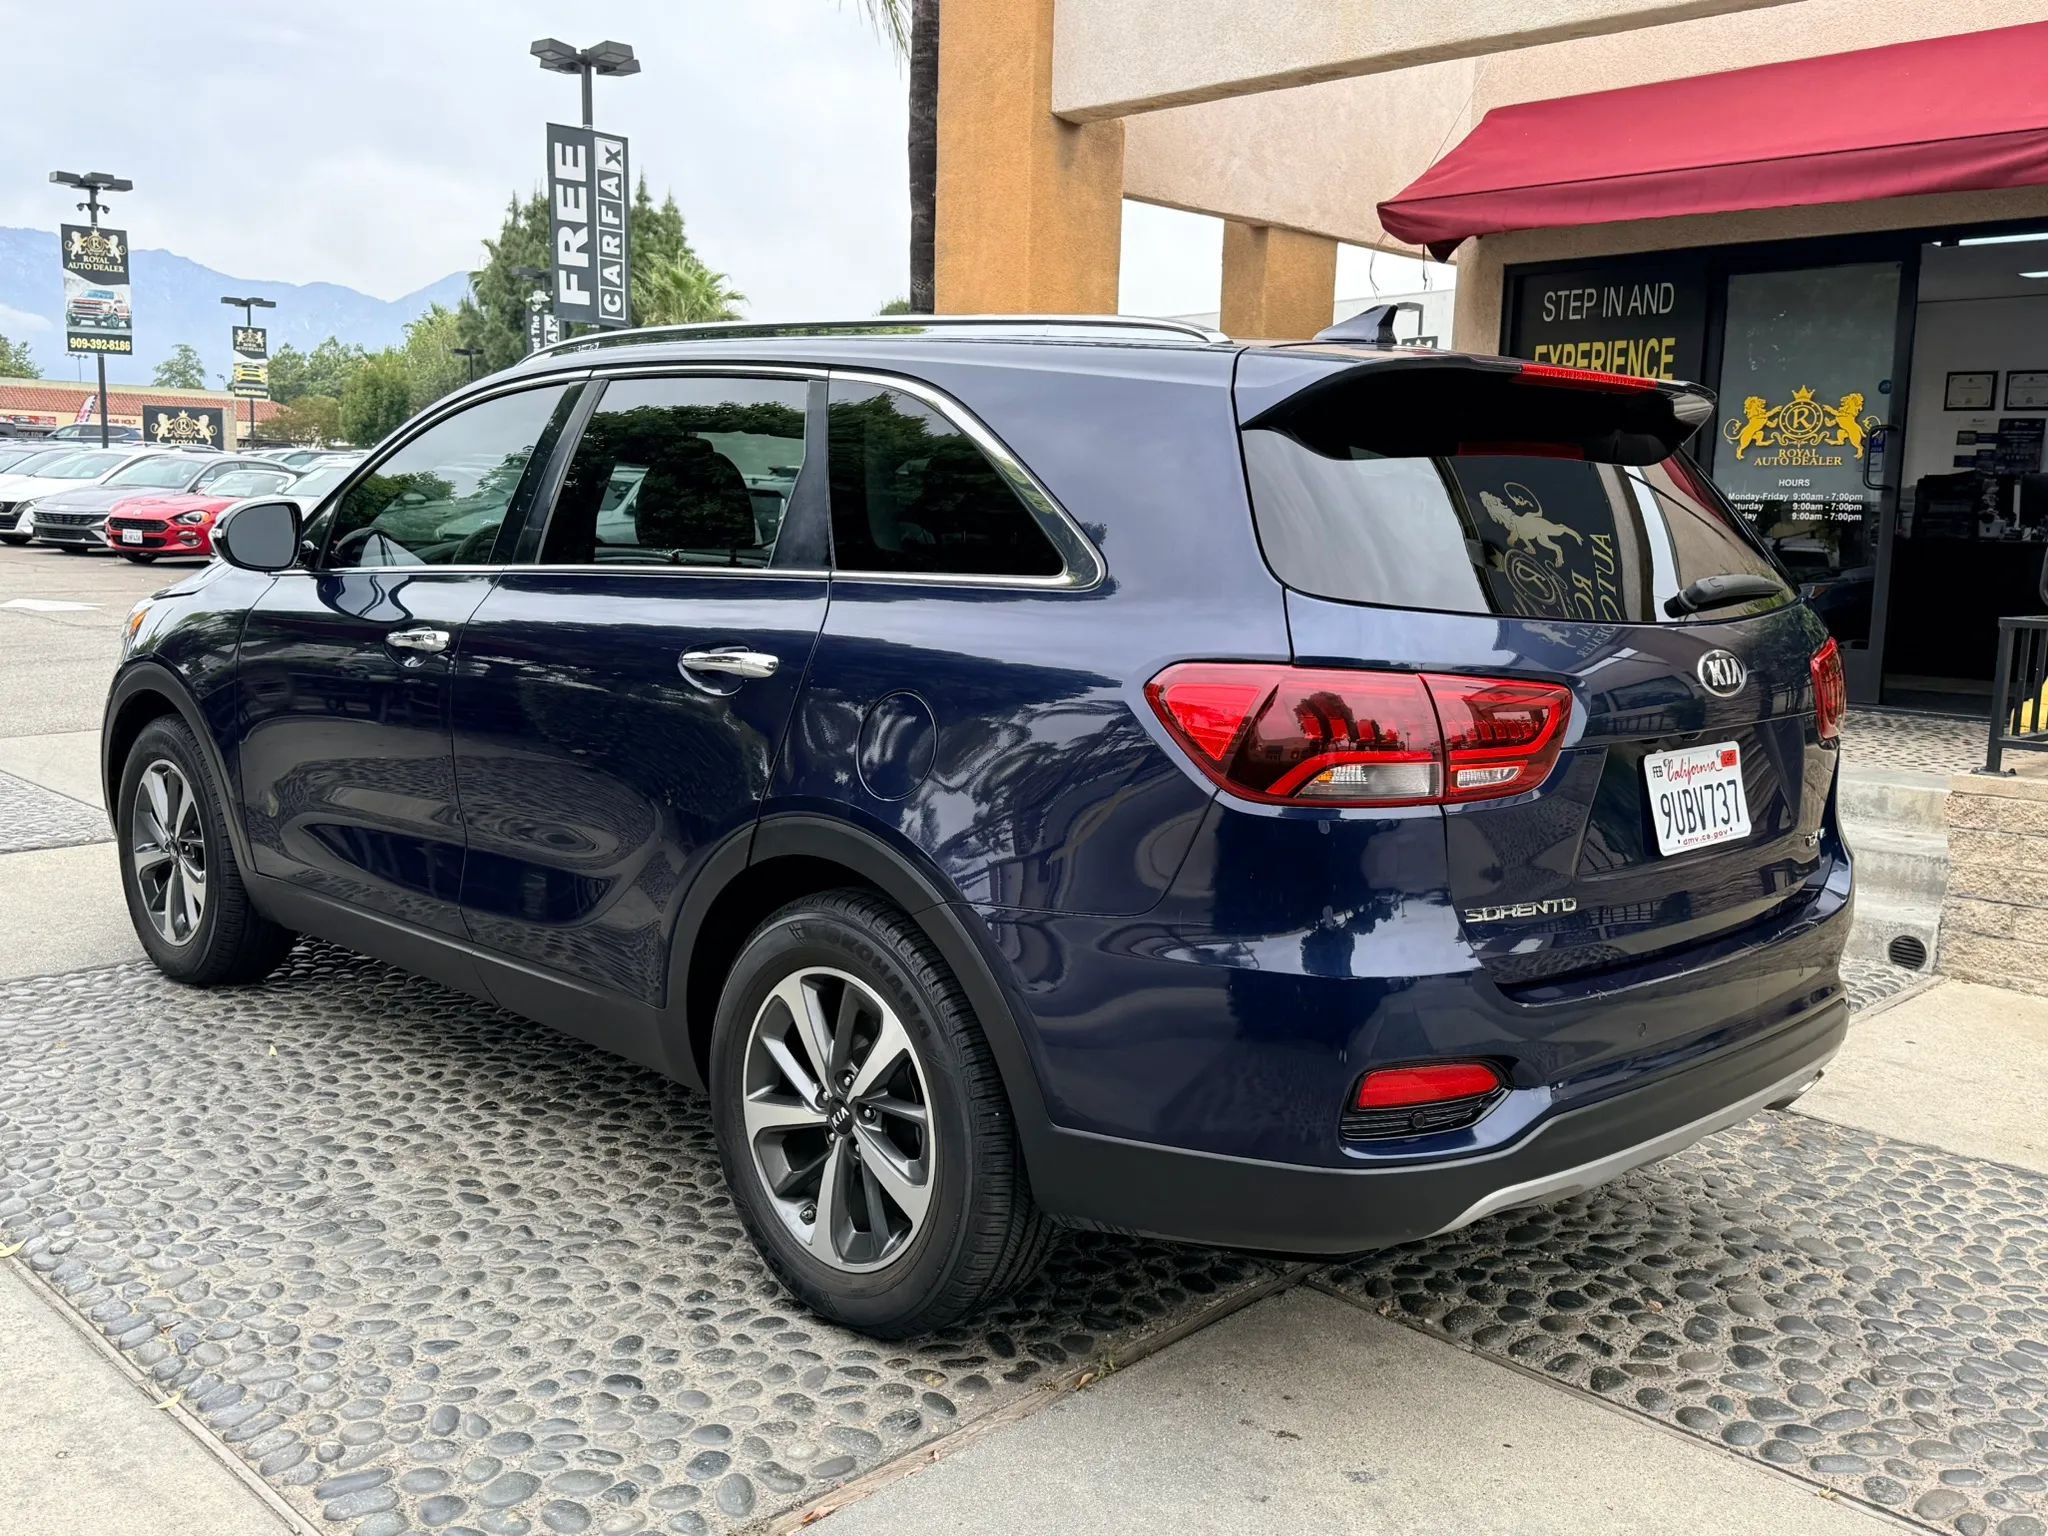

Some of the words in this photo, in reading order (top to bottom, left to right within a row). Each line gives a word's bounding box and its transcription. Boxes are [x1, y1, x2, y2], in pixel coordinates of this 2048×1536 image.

[554, 142, 590, 306] FREE
[600, 145, 622, 313] CARFAX
[68, 262, 92, 271] AUTO
[93, 264, 124, 273] DEALER
[83, 256, 109, 265] ROYAL
[1543, 288, 1597, 321] STEP
[1602, 286, 1623, 318] IN
[1627, 282, 1675, 316] AND
[180, 419, 188, 431] R
[1793, 408, 1812, 429] R
[1779, 449, 1819, 458] ROYAL
[1753, 457, 1790, 466] AUTO
[1791, 457, 1843, 466] DEALER
[1778, 479, 1811, 487] HOURS
[1728, 492, 1789, 502] Monday-Friday
[1792, 493, 1823, 501] 9:00am
[1831, 493, 1863, 502] 7:00pm
[1734, 502, 1764, 512] turday
[1792, 503, 1823, 511] 9:00am
[1830, 503, 1862, 511] 7:00pm
[1791, 513, 1822, 521] 9:00am
[1830, 513, 1862, 521] 7:00pm
[1706, 657, 1742, 686] KIA
[1652, 765, 1664, 779] FEB
[1663, 757, 1723, 785] California
[1660, 779, 1740, 840] 9UBV737
[1683, 829, 1728, 846] dmv.ca.gov
[1464, 897, 1577, 923] SORENTO
[831, 1106, 850, 1127] KIA
